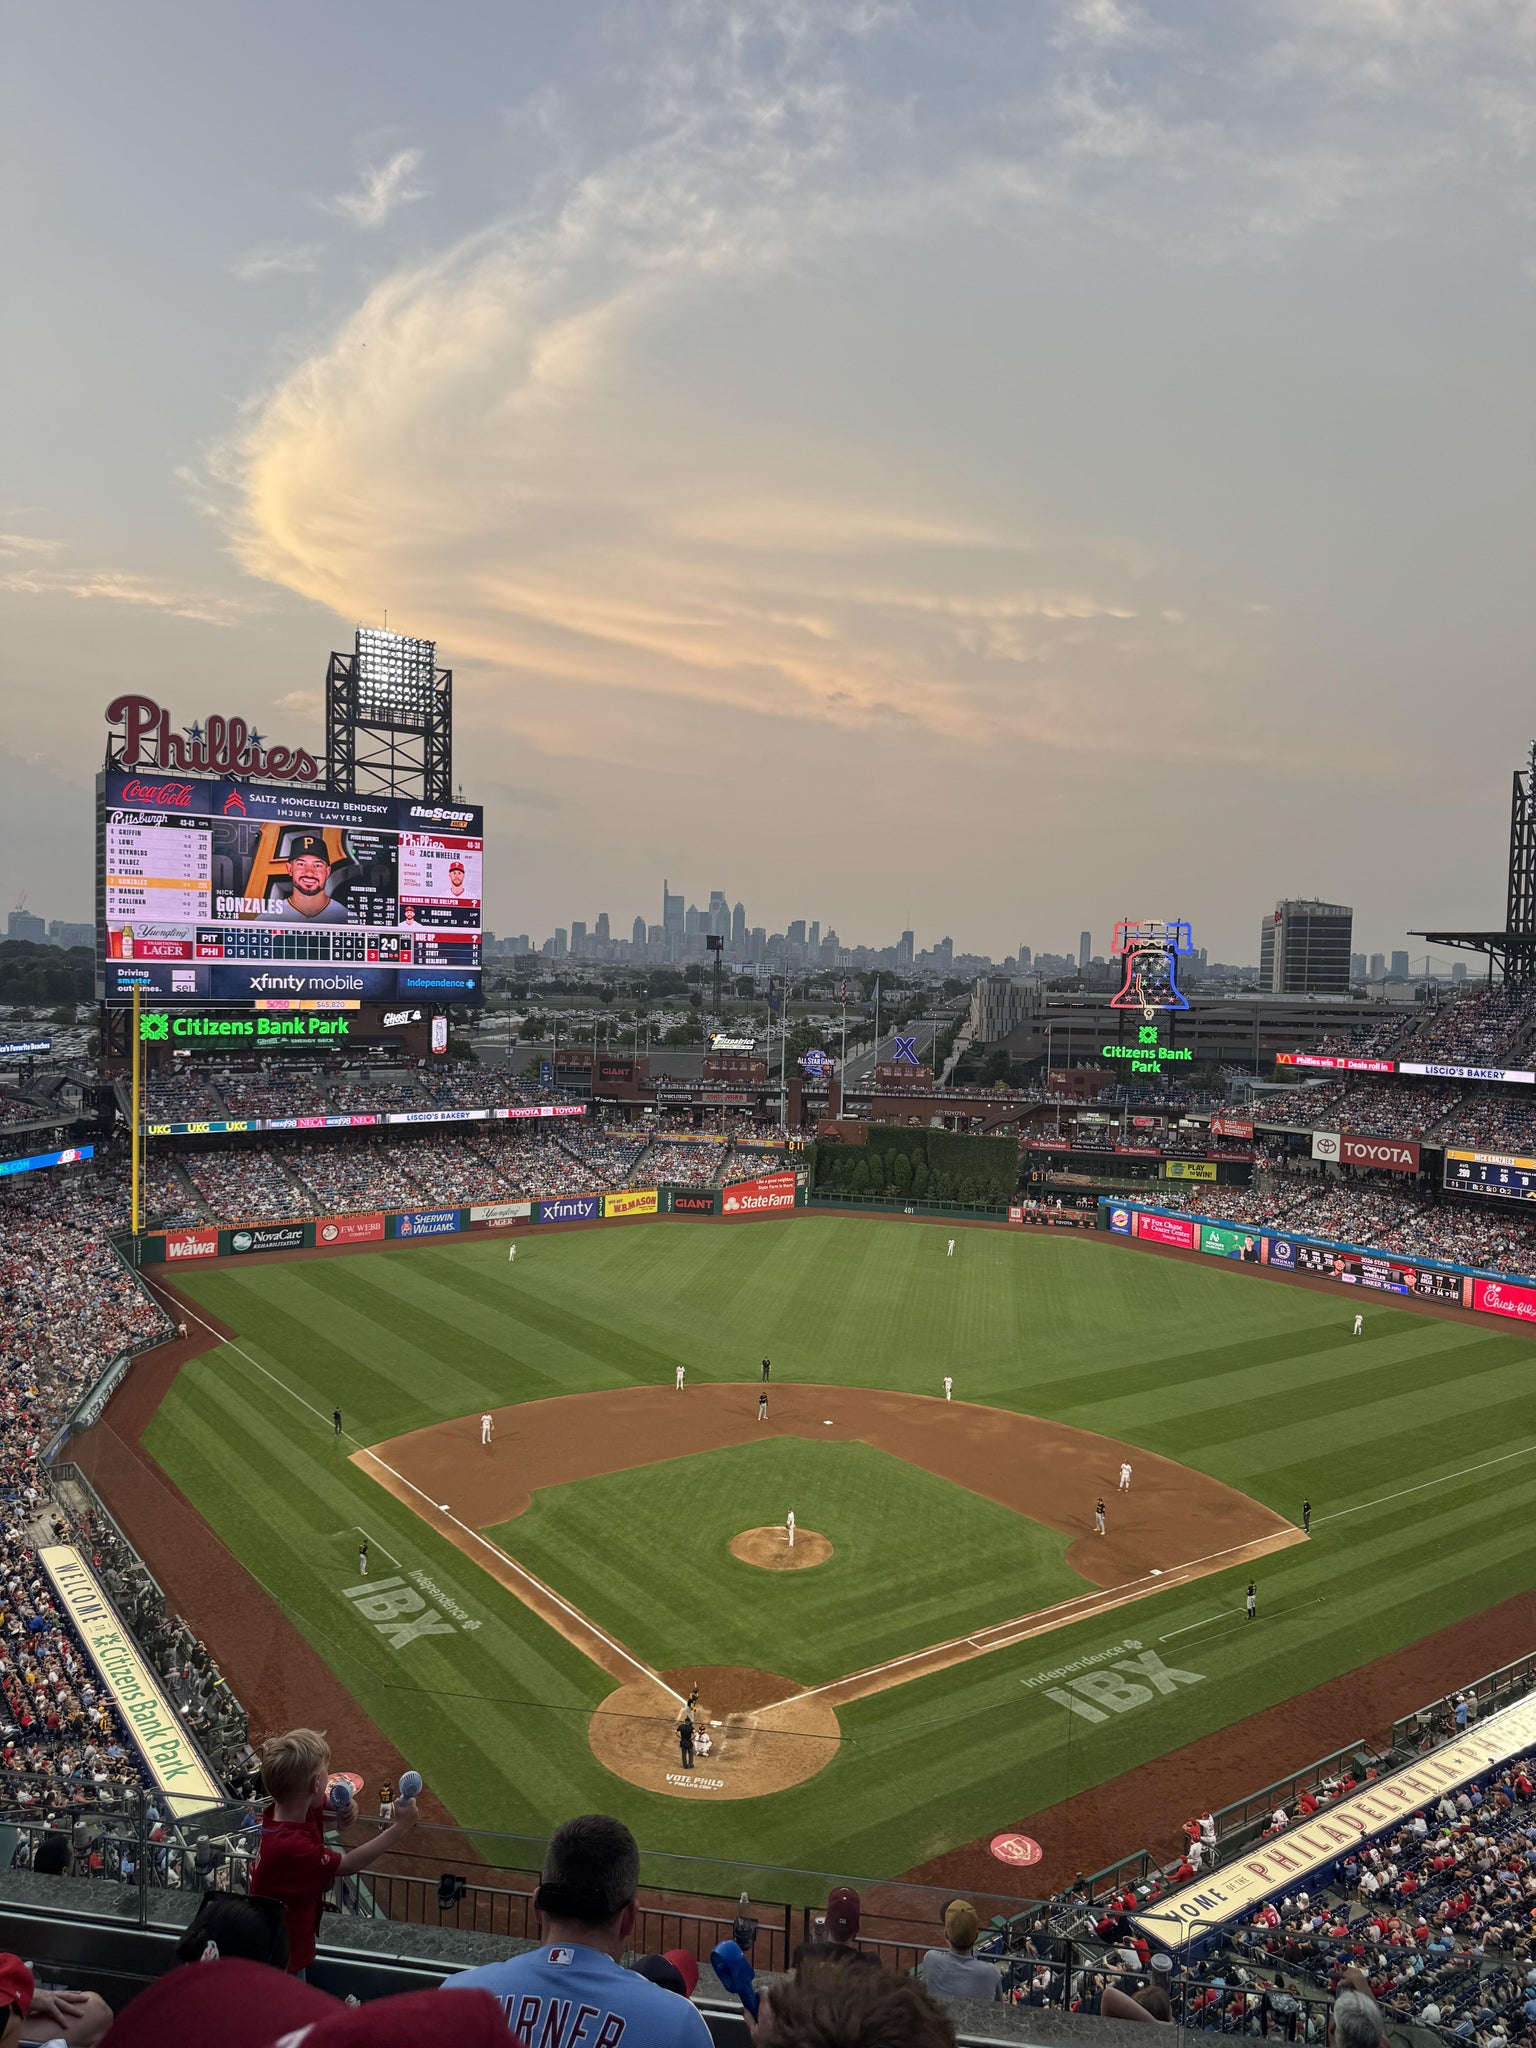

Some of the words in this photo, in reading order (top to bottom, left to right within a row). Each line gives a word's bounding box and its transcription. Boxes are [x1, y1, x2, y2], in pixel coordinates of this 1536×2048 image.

[105, 694, 320, 782] Phillies
[249, 793, 276, 803] SALTZ
[282, 794, 340, 810] MONGELUZZI
[344, 802, 388, 813] BENDESKY
[111, 810, 168, 830] Pittsburgh
[277, 809, 312, 818] INJURY
[320, 812, 362, 822] LAWYERS
[410, 805, 474, 822] theScore
[399, 832, 444, 849] Phillies
[118, 848, 148, 856] REYNOLDS
[420, 849, 435, 857] ZACK
[436, 851, 460, 860] WHEELER
[216, 896, 284, 914] GONZALES
[201, 934, 218, 942] PIT
[381, 938, 399, 950] 2-0
[143, 945, 184, 956] LAGER
[201, 947, 219, 956] PHI
[118, 968, 150, 978] Driving
[250, 972, 306, 991] xfinity
[309, 974, 364, 990] mobile
[407, 978, 466, 989] Independence
[383, 1009, 416, 1027] GHOST
[173, 1017, 254, 1035] Citizens
[257, 1016, 306, 1034] Bank
[308, 1016, 350, 1034] Park
[10, 1043, 30, 1051] Favorite
[892, 1036, 920, 1064] X
[1102, 1045, 1156, 1058] Citizens
[1158, 1046, 1192, 1060] Bank
[1132, 1060, 1162, 1072] Park
[1296, 1057, 1320, 1066] Phillies
[602, 1068, 630, 1076] GIANT
[1425, 1066, 1464, 1076] LISCIO'S
[1467, 1069, 1506, 1080] BAKERY
[299, 1118, 323, 1126] NECA
[406, 1112, 438, 1121] LISCIO'S
[440, 1112, 470, 1120] BAKERY
[148, 1124, 172, 1134] UKG
[187, 1122, 210, 1133] UKG
[226, 1121, 248, 1132] UKG
[1344, 1142, 1414, 1165] TOYOTA
[543, 1201, 594, 1219] xfinity
[675, 1198, 712, 1208] GIANT
[904, 1206, 915, 1214] 401
[414, 1213, 454, 1224] SHERWIN
[488, 1218, 514, 1227] LAGER
[1152, 1218, 1163, 1227] Fox
[1163, 1221, 1183, 1232] Chase
[356, 1222, 382, 1232] WEBB
[413, 1222, 456, 1235] WILLIAMS.
[1151, 1225, 1170, 1234] Cancer
[1171, 1228, 1191, 1238] Center
[253, 1229, 302, 1244] NovaCare
[168, 1241, 216, 1257] Wawa
[253, 1240, 300, 1249] REHABILITATION
[1483, 1287, 1536, 1316] Chick-fil-
[54, 1561, 108, 1624] WELCOME
[407, 1568, 468, 1620] Independence
[341, 1575, 458, 1649] IBX
[1020, 1645, 1126, 1688] Independence
[1040, 1648, 1207, 1724] IBX
[98, 1644, 146, 1701] Citizens
[128, 1698, 168, 1743] Bank
[149, 1738, 188, 1782] Park
[666, 1773, 692, 1782] VOTE
[693, 1776, 724, 1787] PHILS
[1165, 1886, 1228, 1924] HOME
[1244, 1760, 1464, 1884] PHILADELPHIA
